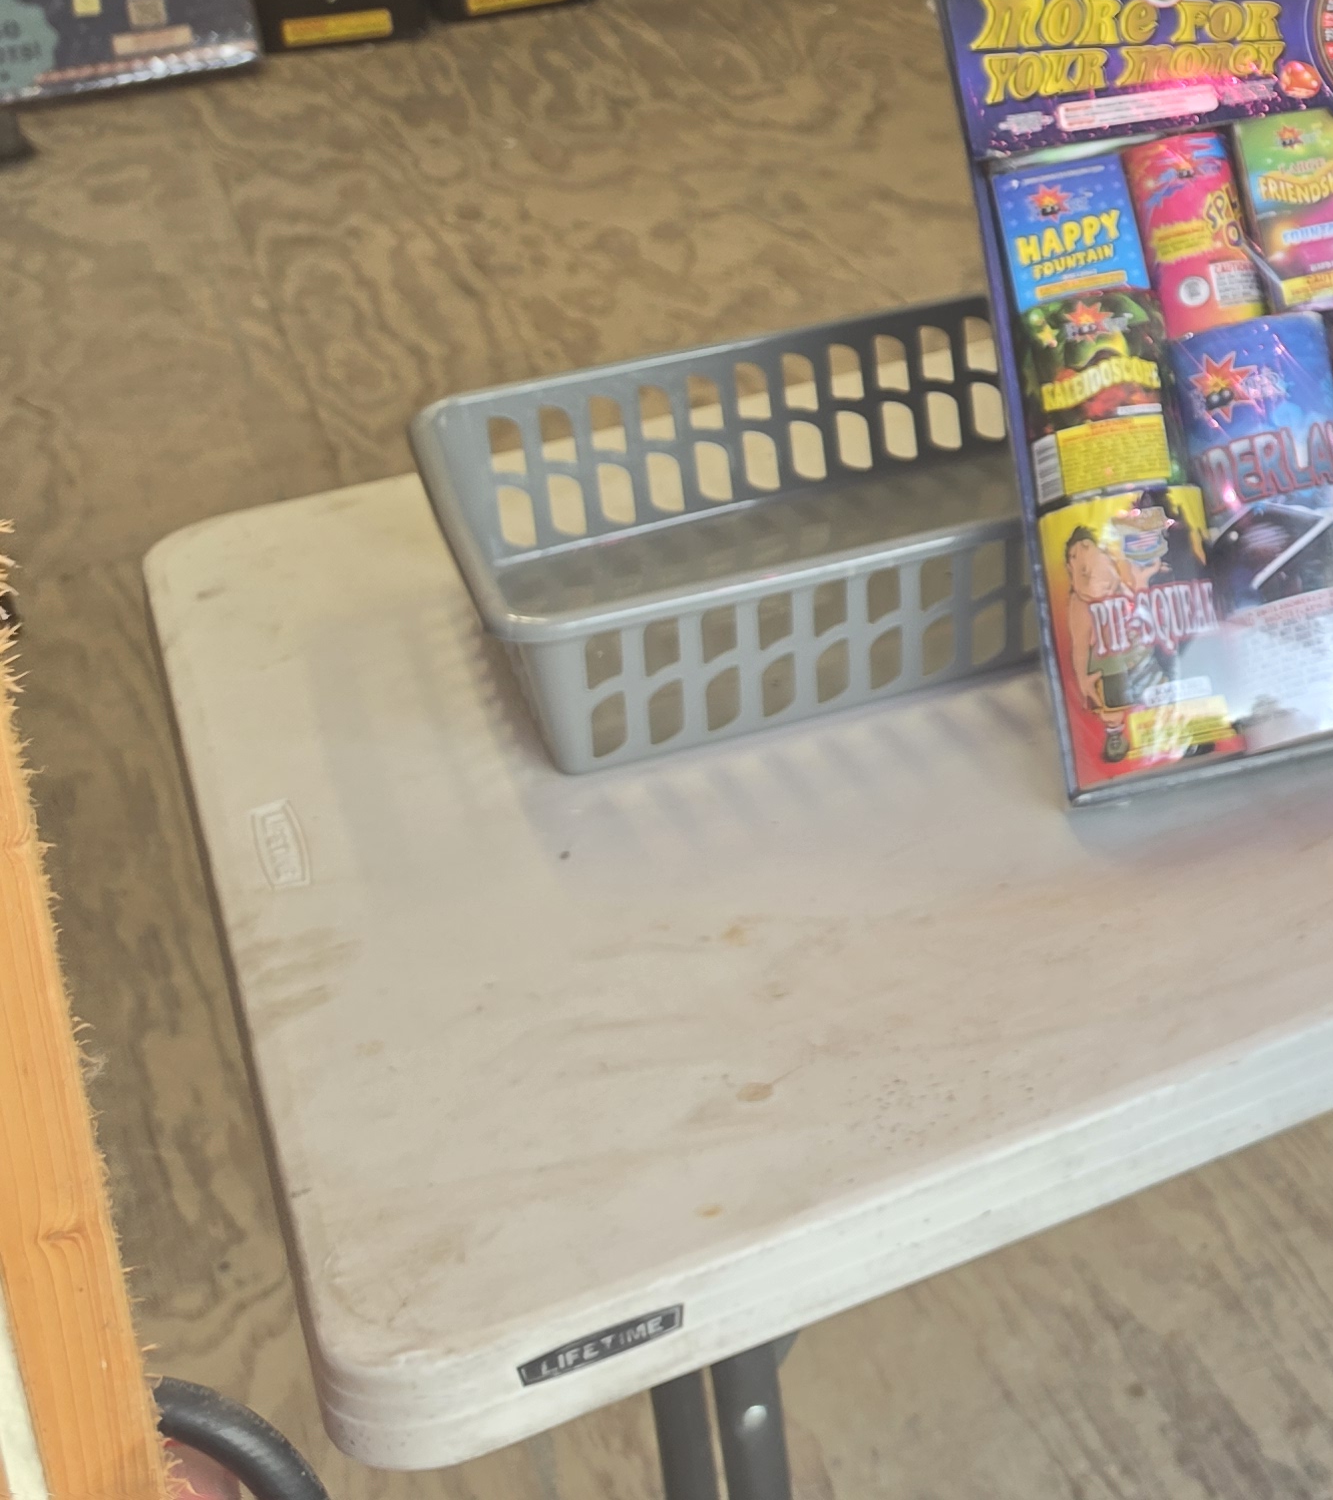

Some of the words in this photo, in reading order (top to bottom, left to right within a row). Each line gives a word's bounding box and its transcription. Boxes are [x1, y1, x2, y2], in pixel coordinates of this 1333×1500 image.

[1171, 0, 1283, 44] FOR
[983, 47, 1111, 105] YOUR
[1115, 41, 1287, 88] MONEY
[1016, 209, 1120, 266] HAPPY
[1033, 243, 1114, 281] FOUNTAIN
[1041, 356, 1162, 413] KALEIDOSCOPE
[541, 1315, 665, 1377] LIFETIME
